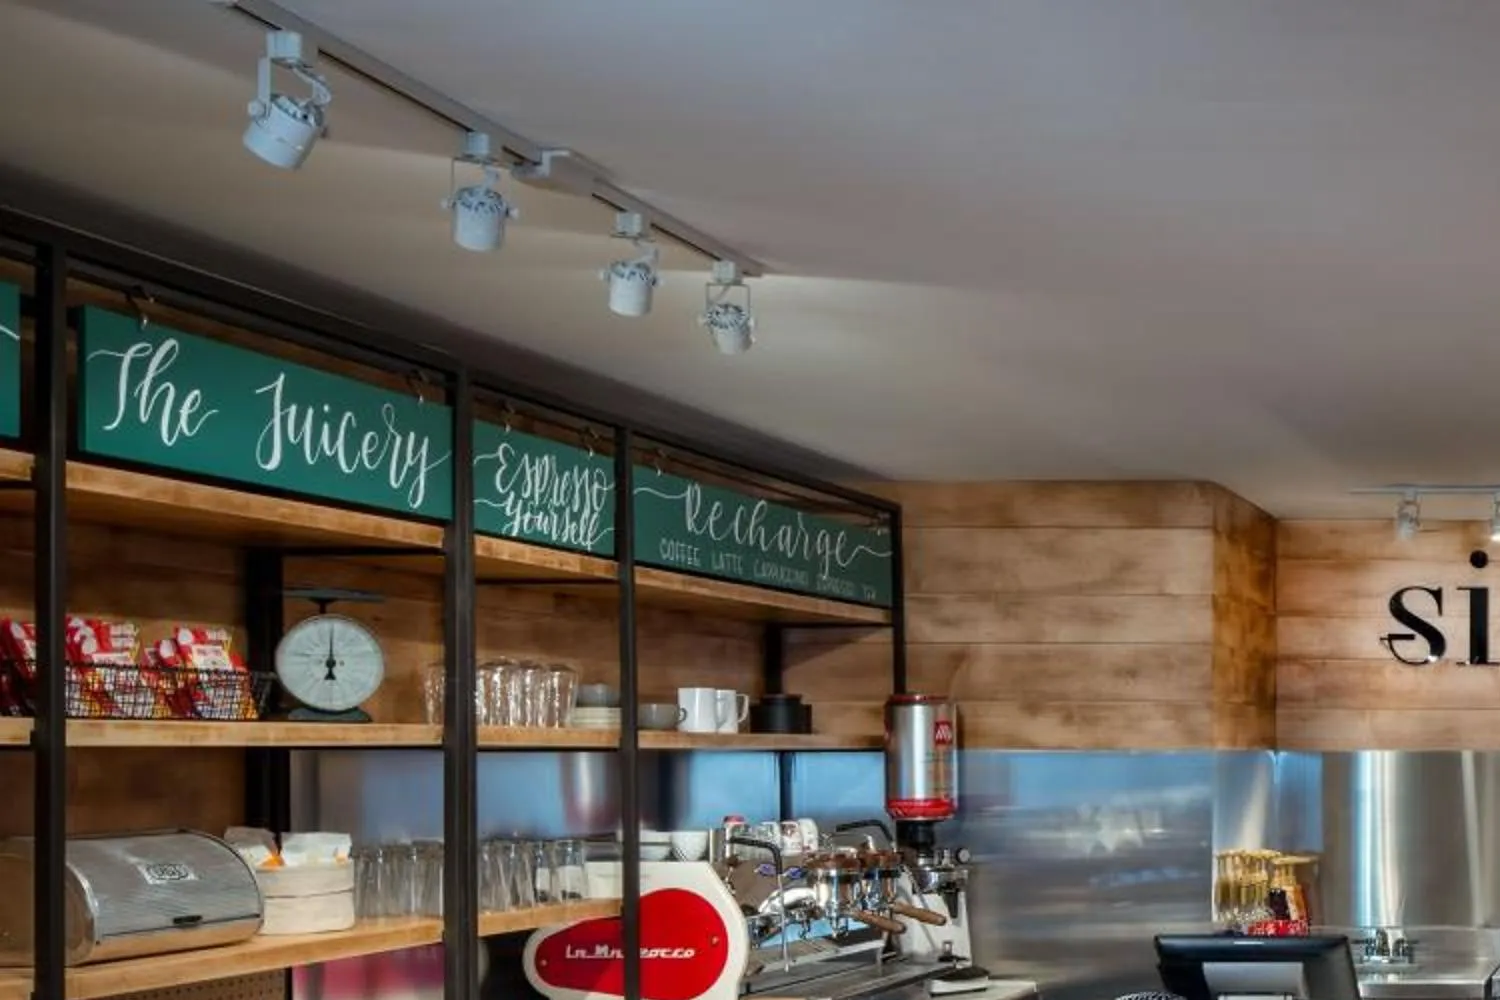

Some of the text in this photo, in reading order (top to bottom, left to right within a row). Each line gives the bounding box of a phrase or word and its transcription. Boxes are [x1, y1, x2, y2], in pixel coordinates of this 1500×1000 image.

[86, 337, 452, 510] The Juicery
[473, 443, 614, 513] Espresso
[633, 482, 892, 580] Recharge
[659, 537, 701, 567] COFFEE
[711, 551, 744, 577] LATTE
